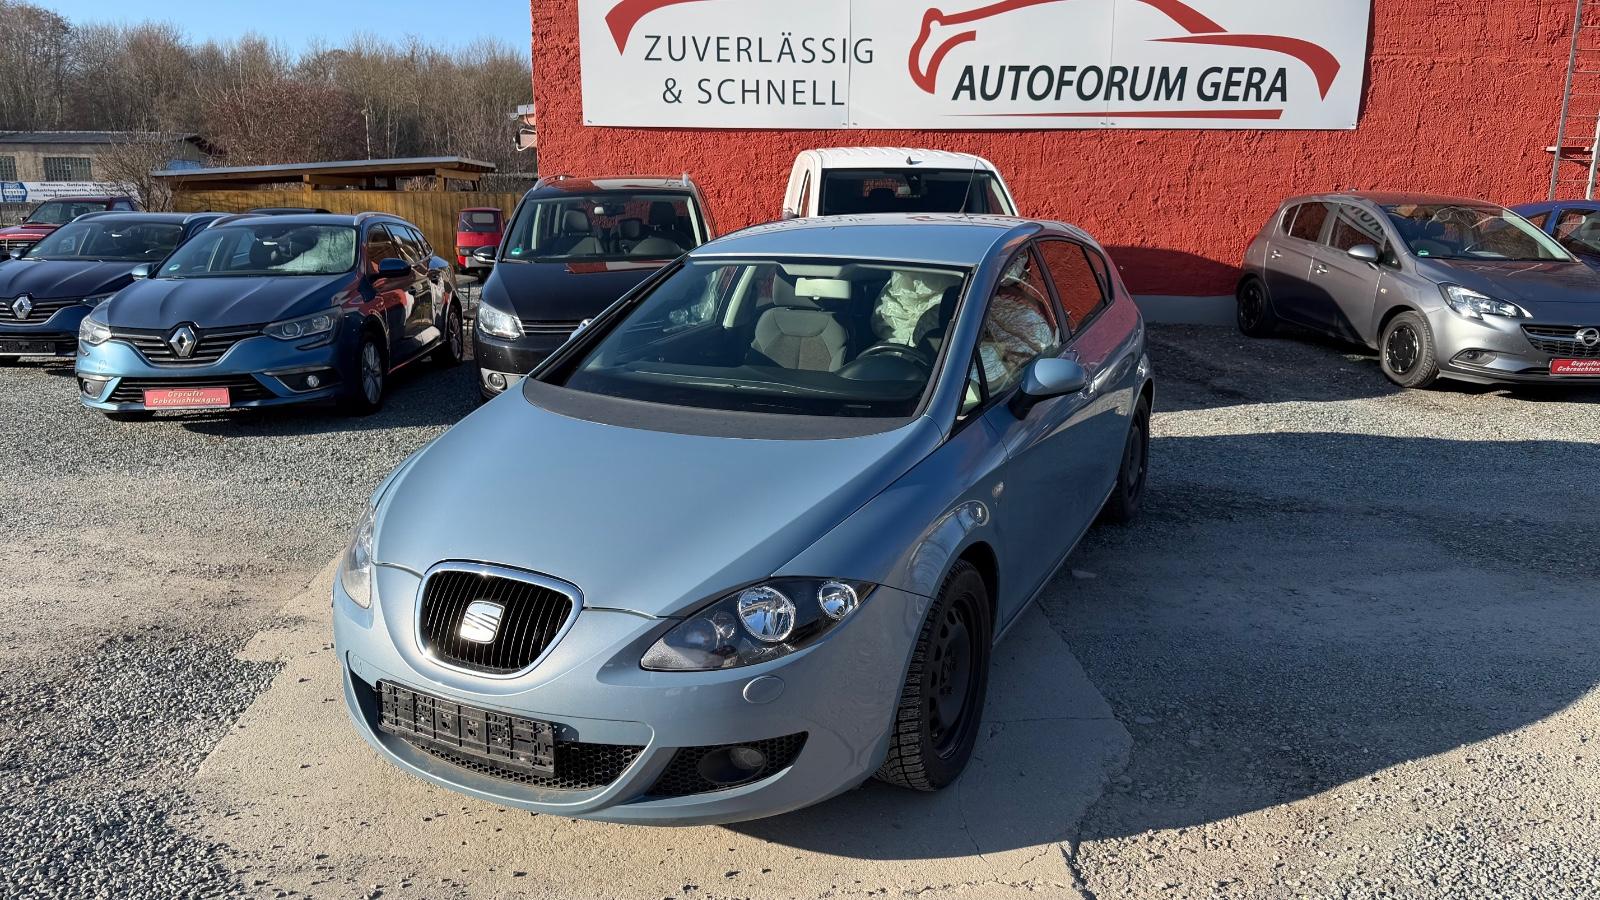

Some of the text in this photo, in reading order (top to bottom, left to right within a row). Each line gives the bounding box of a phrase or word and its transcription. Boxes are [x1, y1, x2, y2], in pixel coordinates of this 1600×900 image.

[644, 32, 874, 64] ZUVERLÄSSIG
[662, 77, 845, 106] & SCHNELL
[952, 65, 1288, 103] AUTOFORUM GERA
